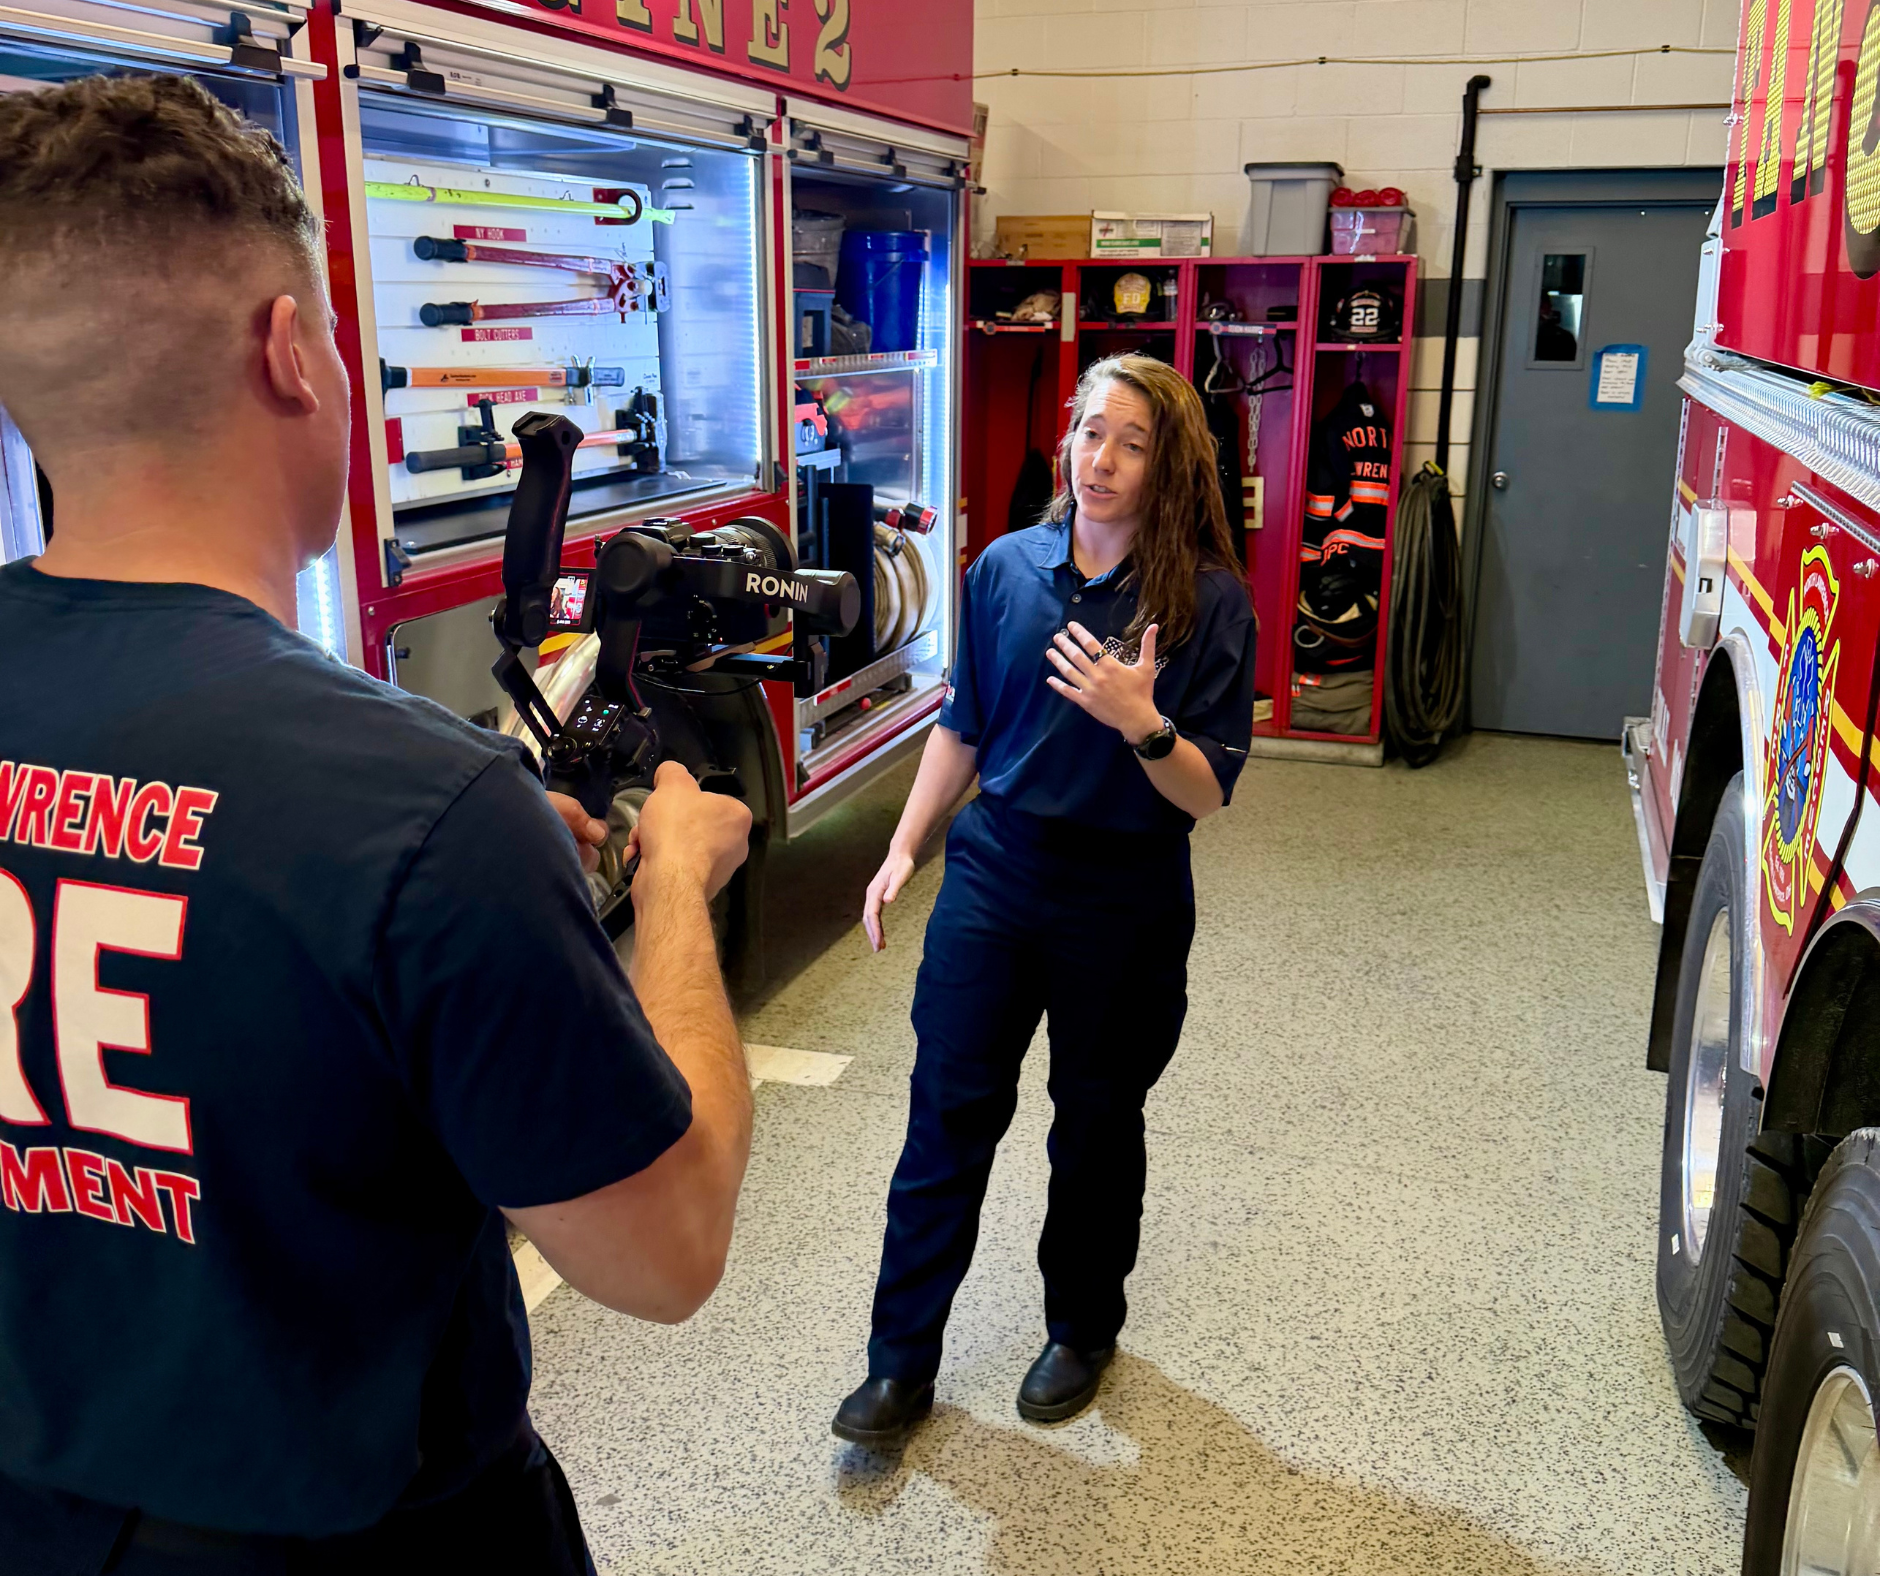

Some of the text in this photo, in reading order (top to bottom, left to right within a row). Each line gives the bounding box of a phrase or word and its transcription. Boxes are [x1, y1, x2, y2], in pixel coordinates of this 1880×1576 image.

[1350, 307, 1379, 326] 22
[1341, 425, 1388, 452] NORT
[1350, 461, 1388, 479] WREN
[745, 572, 809, 604] RONIN
[1771, 643, 1790, 759] FIRE
[1804, 687, 1832, 860] RESCUE
[0, 1139, 201, 1245] MENT
